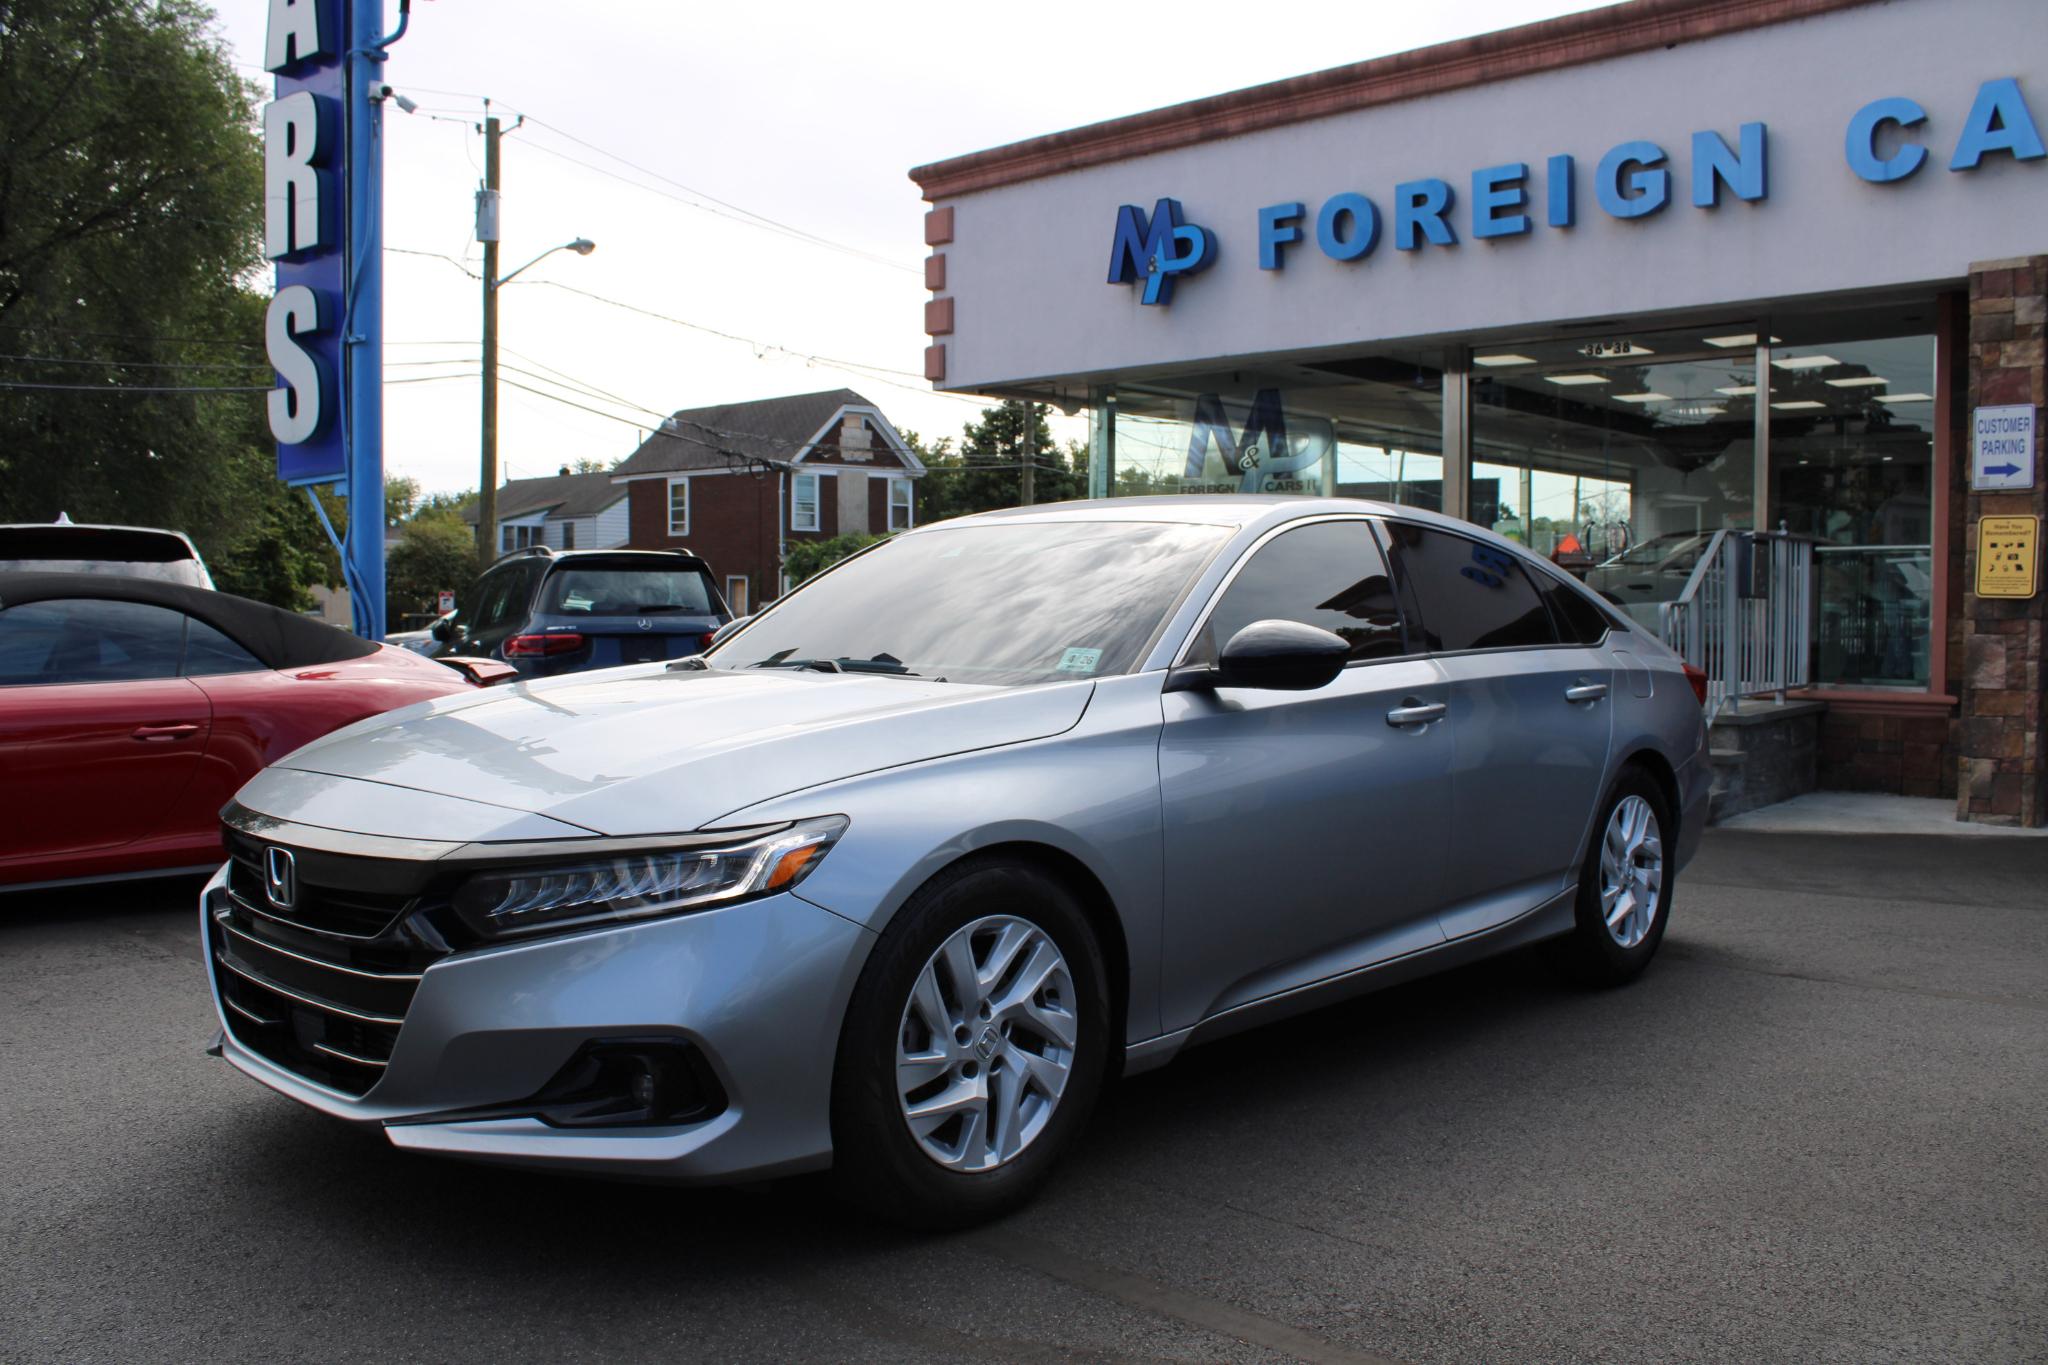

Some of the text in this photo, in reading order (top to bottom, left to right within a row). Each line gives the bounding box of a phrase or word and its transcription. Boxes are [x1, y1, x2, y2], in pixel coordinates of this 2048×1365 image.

[1258, 122, 1768, 271] FOREIGN
[1845, 76, 2048, 184] CA
[1977, 416, 2031, 434] CUSTOMER
[1981, 438, 2026, 456] PARKING
[1180, 484, 1235, 494] FOREIGN
[1265, 480, 1303, 492] CARS
